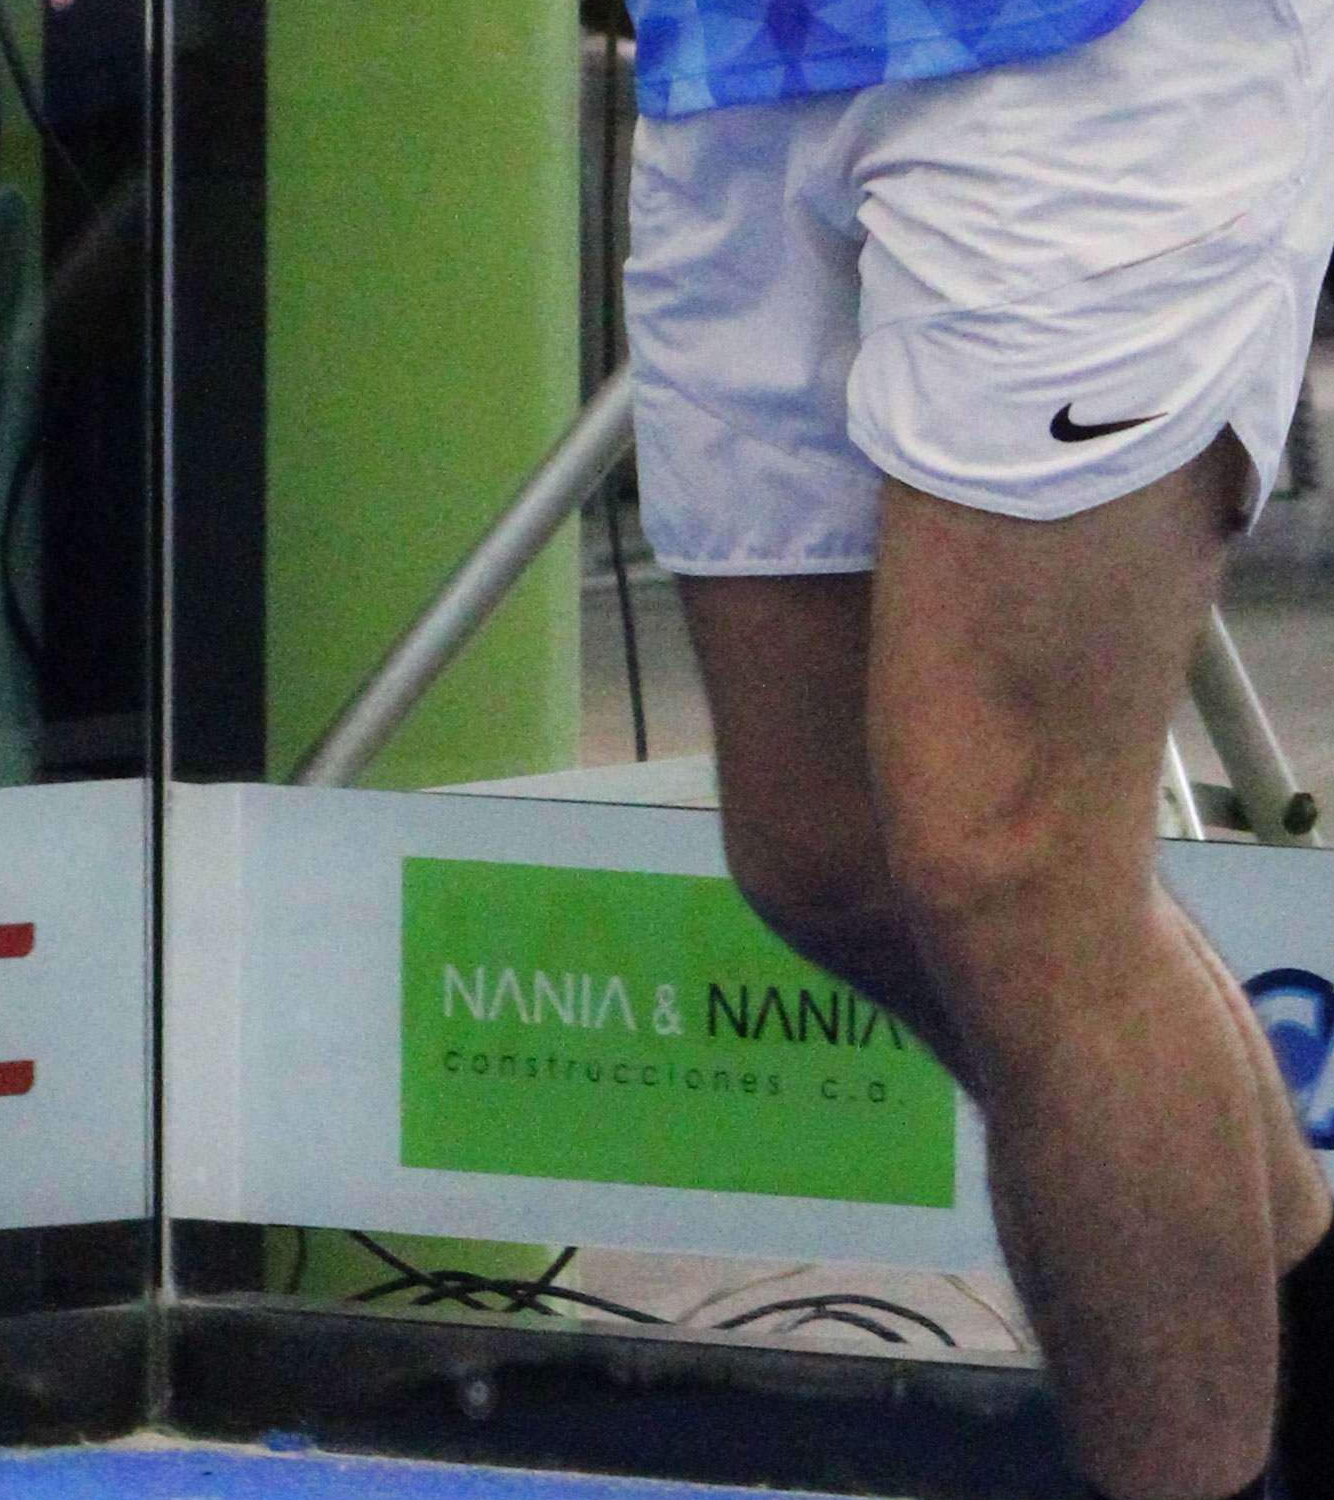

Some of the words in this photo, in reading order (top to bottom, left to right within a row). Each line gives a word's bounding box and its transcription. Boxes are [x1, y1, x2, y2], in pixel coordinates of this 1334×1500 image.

[442, 963, 637, 1031] NANIA
[654, 983, 684, 1036] &
[443, 1048, 782, 1096] construcciones
